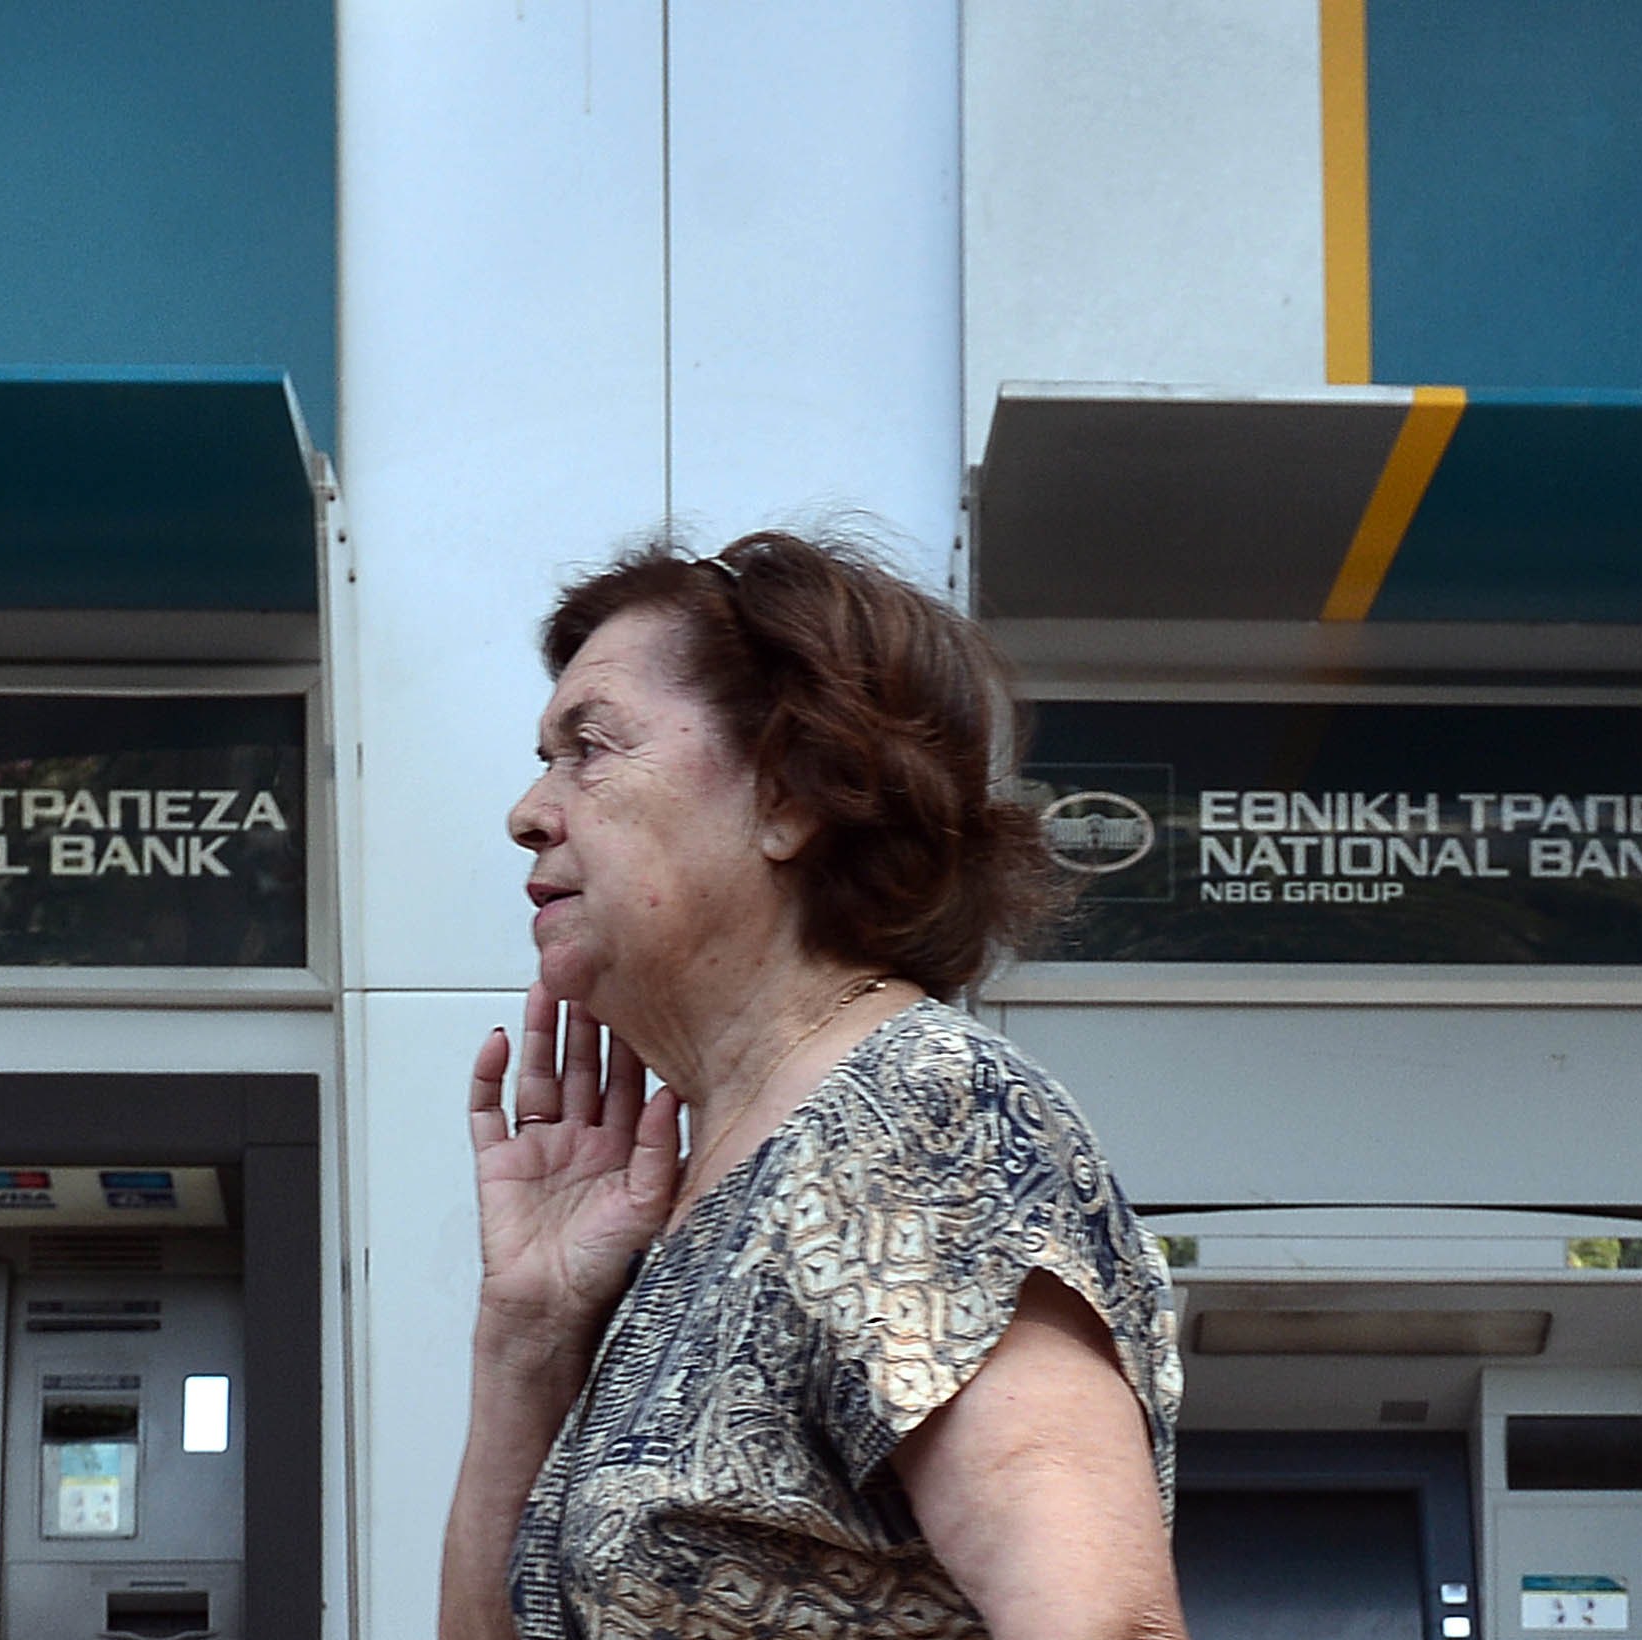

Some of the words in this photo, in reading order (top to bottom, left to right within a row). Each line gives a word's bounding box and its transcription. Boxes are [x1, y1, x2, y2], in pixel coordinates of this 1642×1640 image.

[1200, 790, 1439, 832] ΕΘΝΙΚΗ
[50, 834, 231, 877] BANK
[1200, 835, 1509, 877] NATIONAL
[1200, 881, 1272, 903] NBG
[1282, 881, 1405, 903] GROUP
